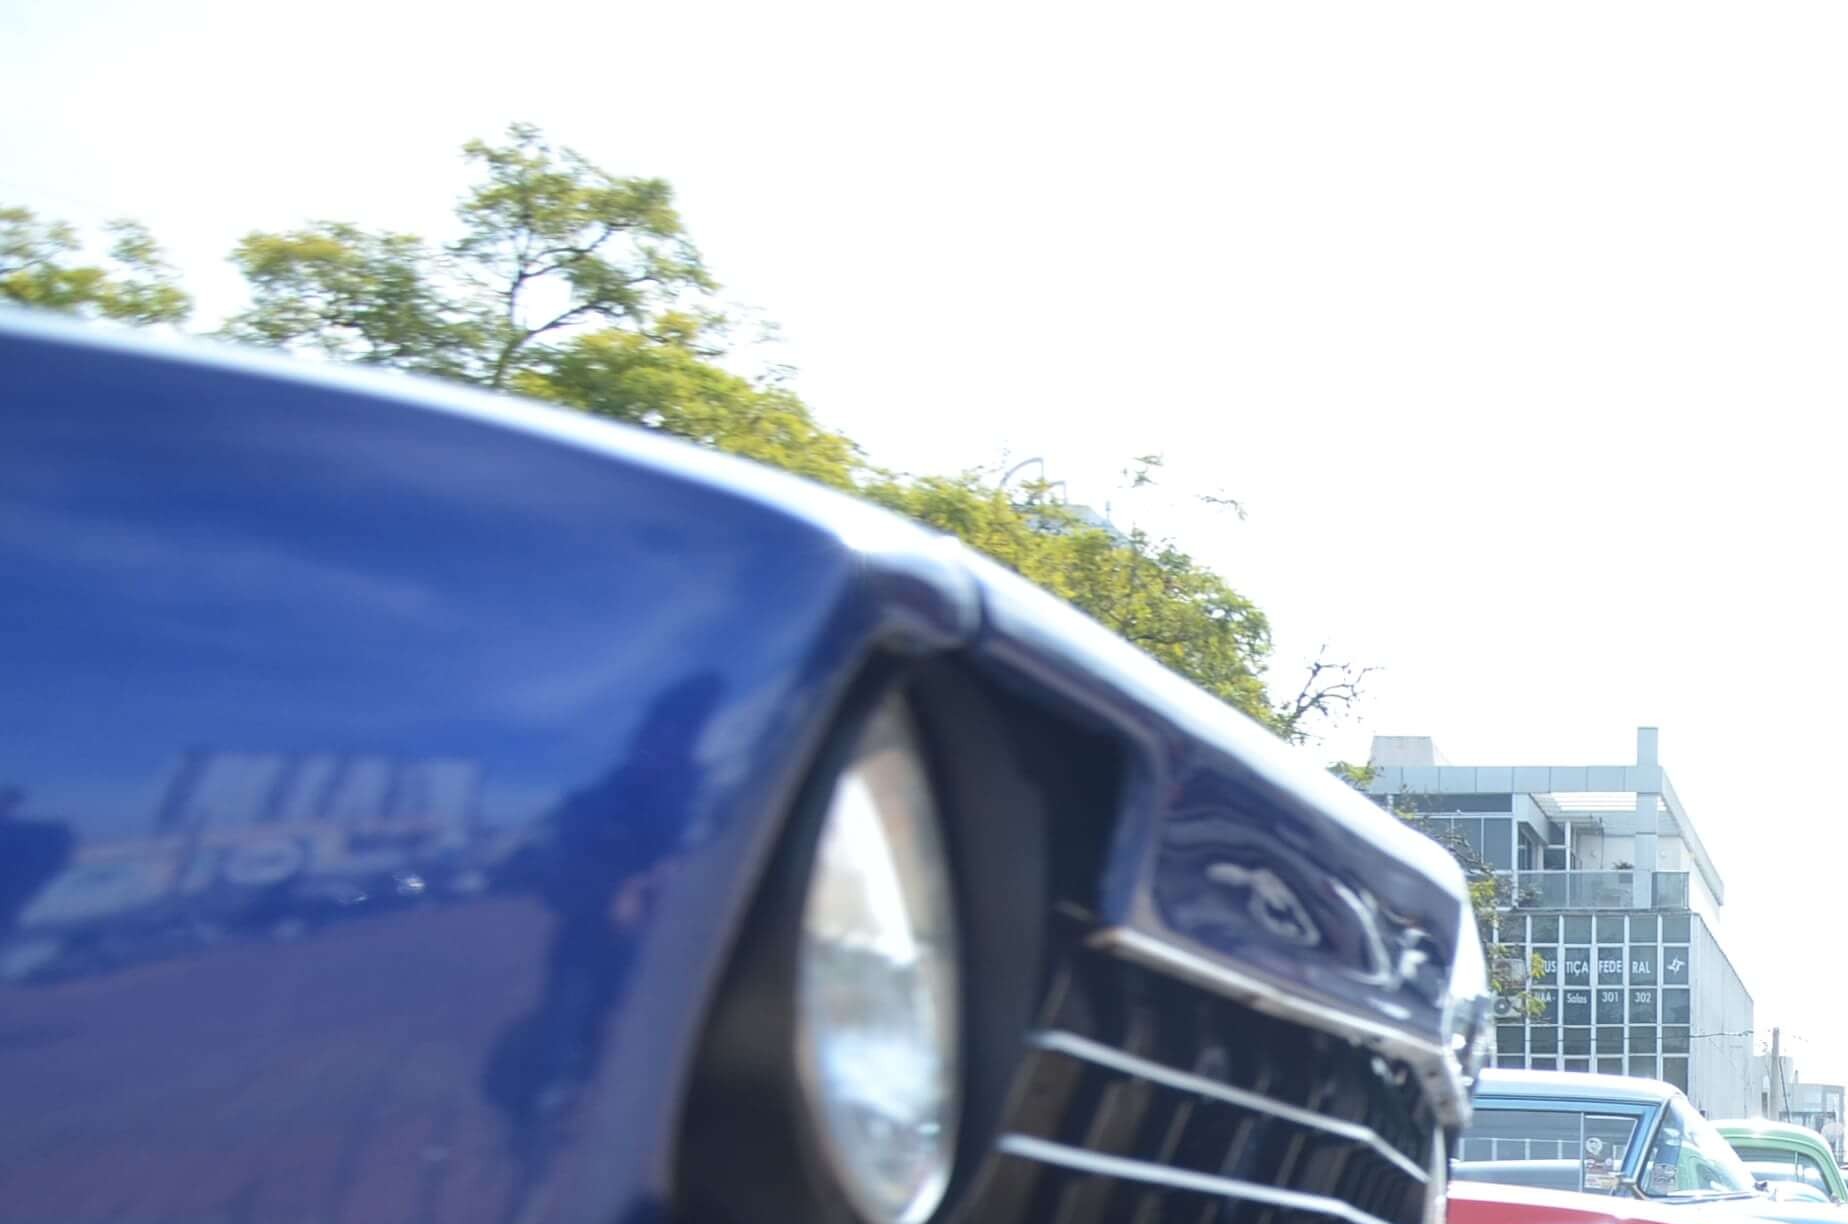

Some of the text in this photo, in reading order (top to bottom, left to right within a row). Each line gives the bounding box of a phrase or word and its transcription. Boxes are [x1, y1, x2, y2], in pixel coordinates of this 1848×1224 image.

[1599, 960, 1651, 974] FEDERAL
[1567, 992, 1587, 1005] Salas
[1602, 991, 1618, 1003] 301
[1635, 991, 1651, 1003] 302
